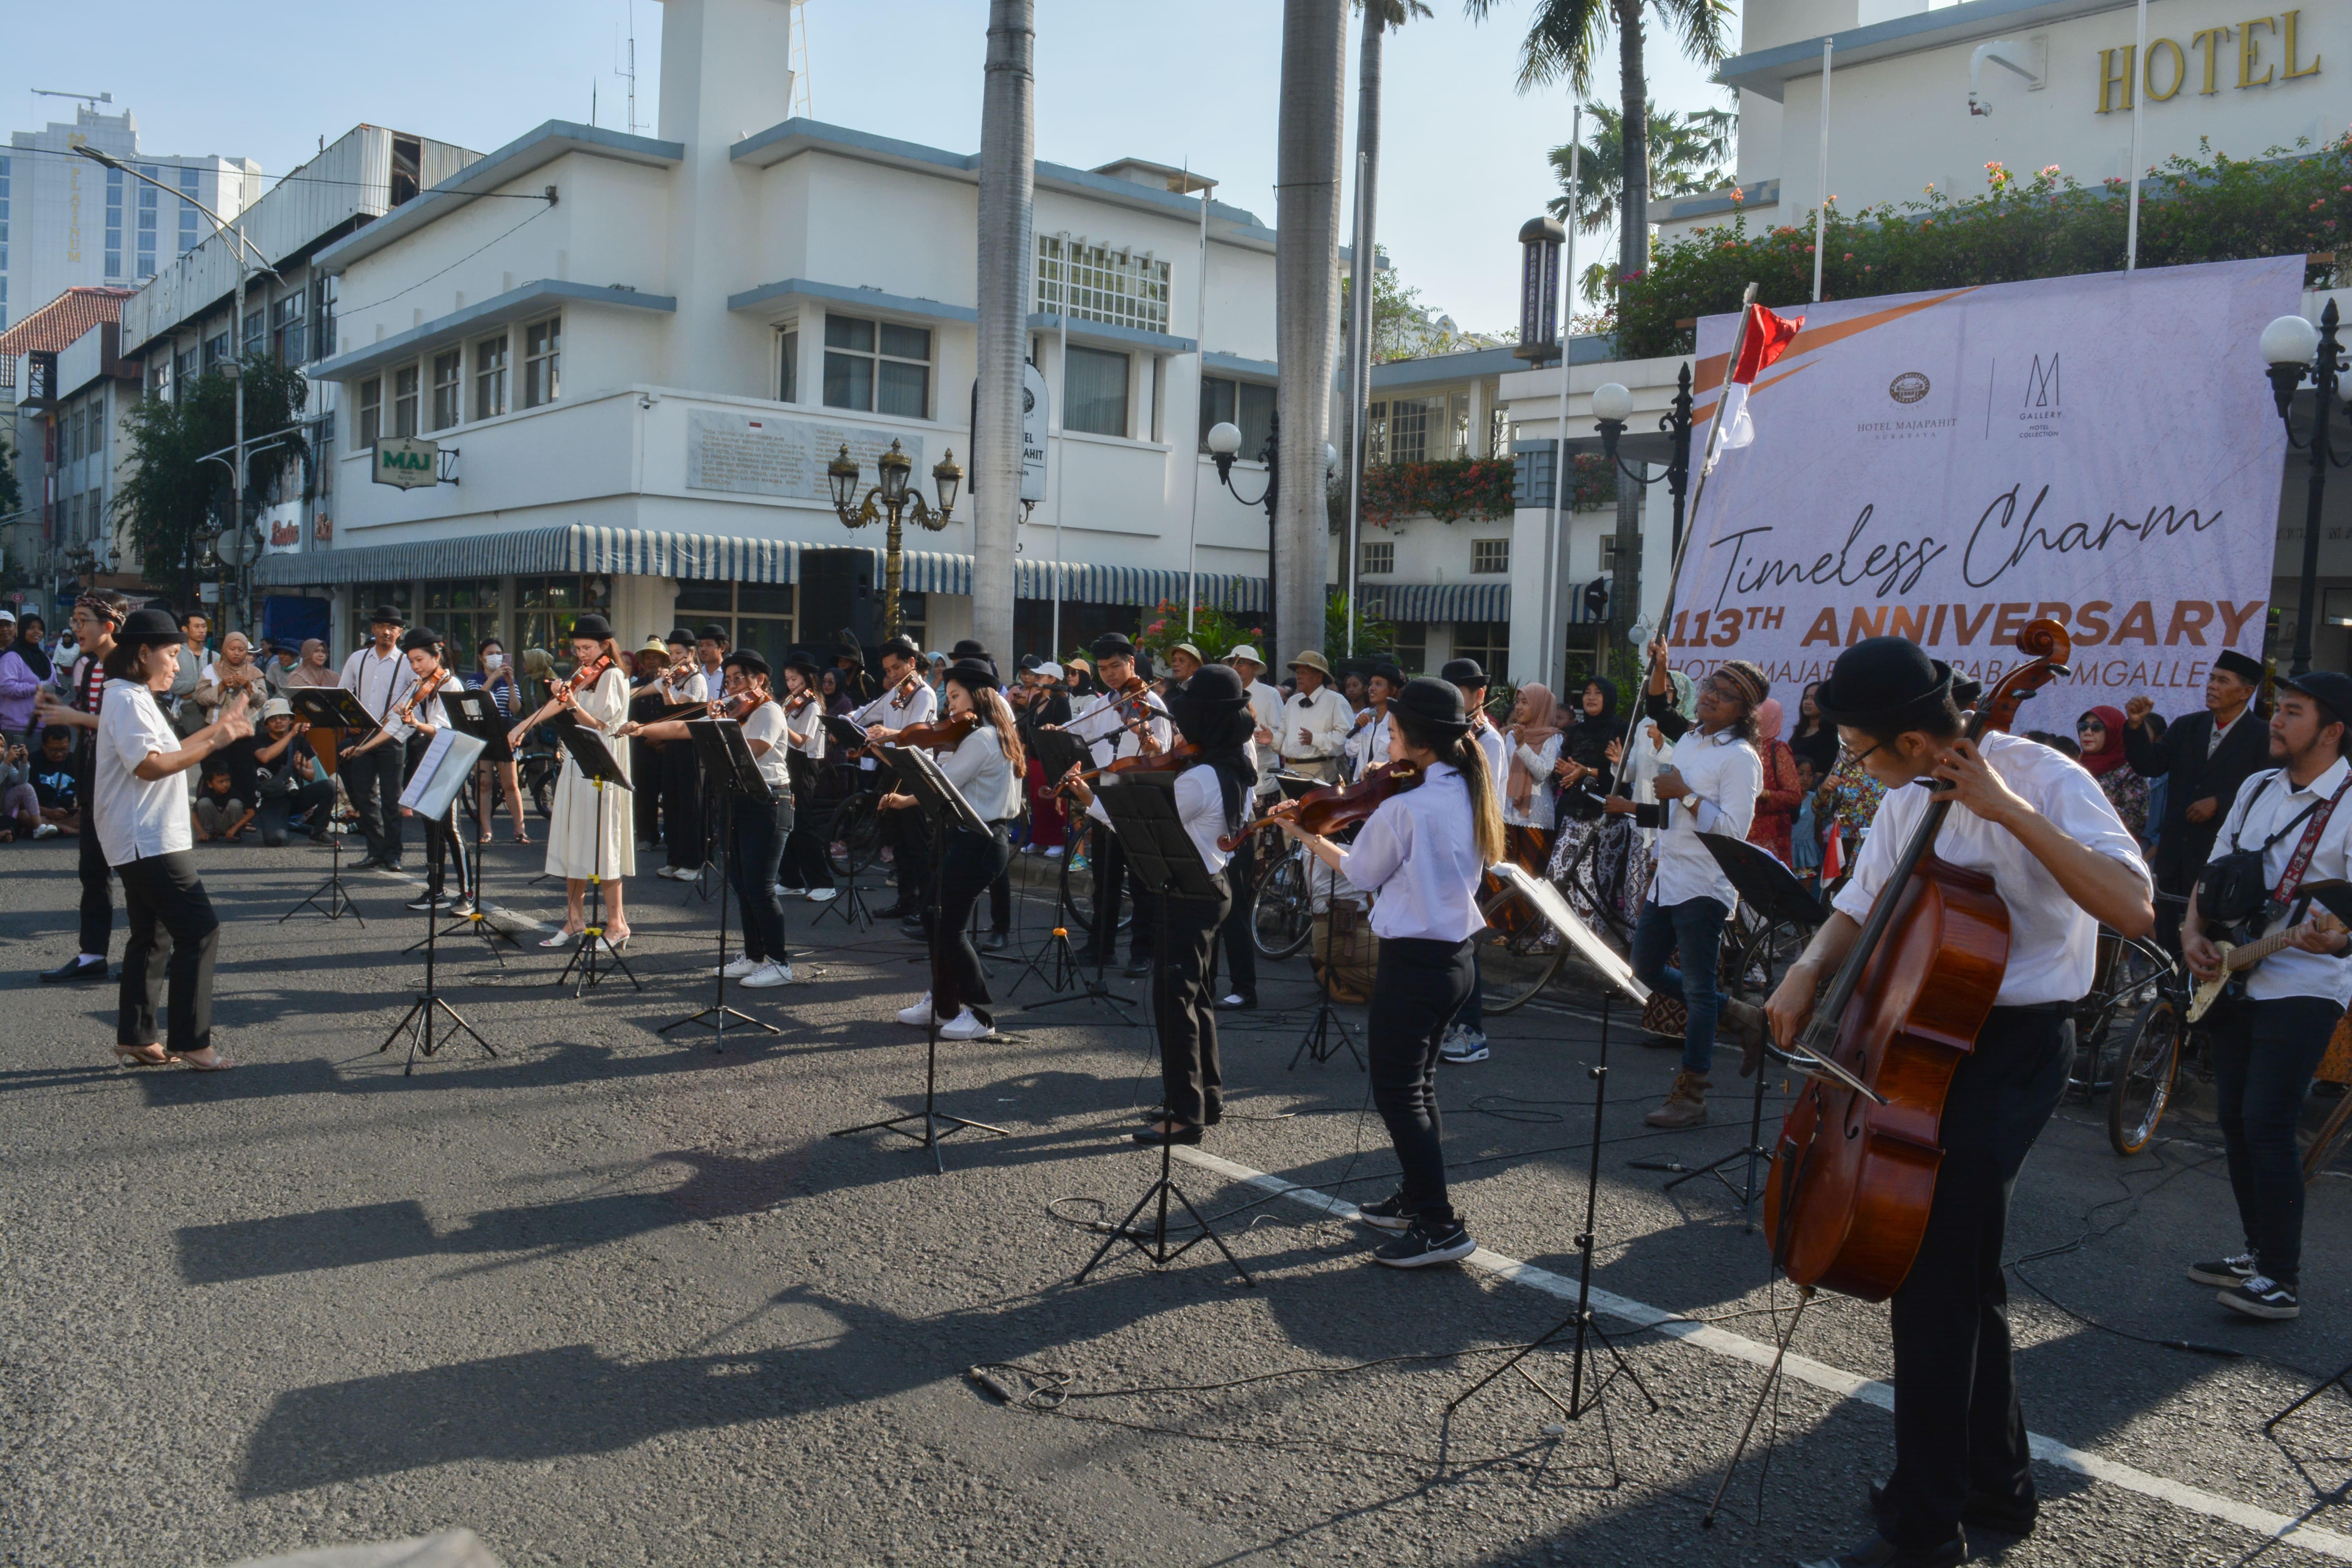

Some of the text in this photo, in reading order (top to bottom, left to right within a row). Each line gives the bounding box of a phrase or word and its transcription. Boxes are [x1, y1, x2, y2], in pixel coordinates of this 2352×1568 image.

[2094, 9, 2321, 113] HOTEL
[67, 167, 82, 263] PLATINUM
[1858, 418, 1957, 432] HOTEL MAJAPAHIT
[2019, 411, 2062, 420] GALLERY
[1875, 432, 1936, 440] SURABAYA
[383, 450, 430, 470] MAJ
[1710, 483, 2222, 614] Timeless Charm
[1668, 601, 2267, 648] 113TH ANNIVERSARY
[2069, 660, 2211, 688] MGALLE
